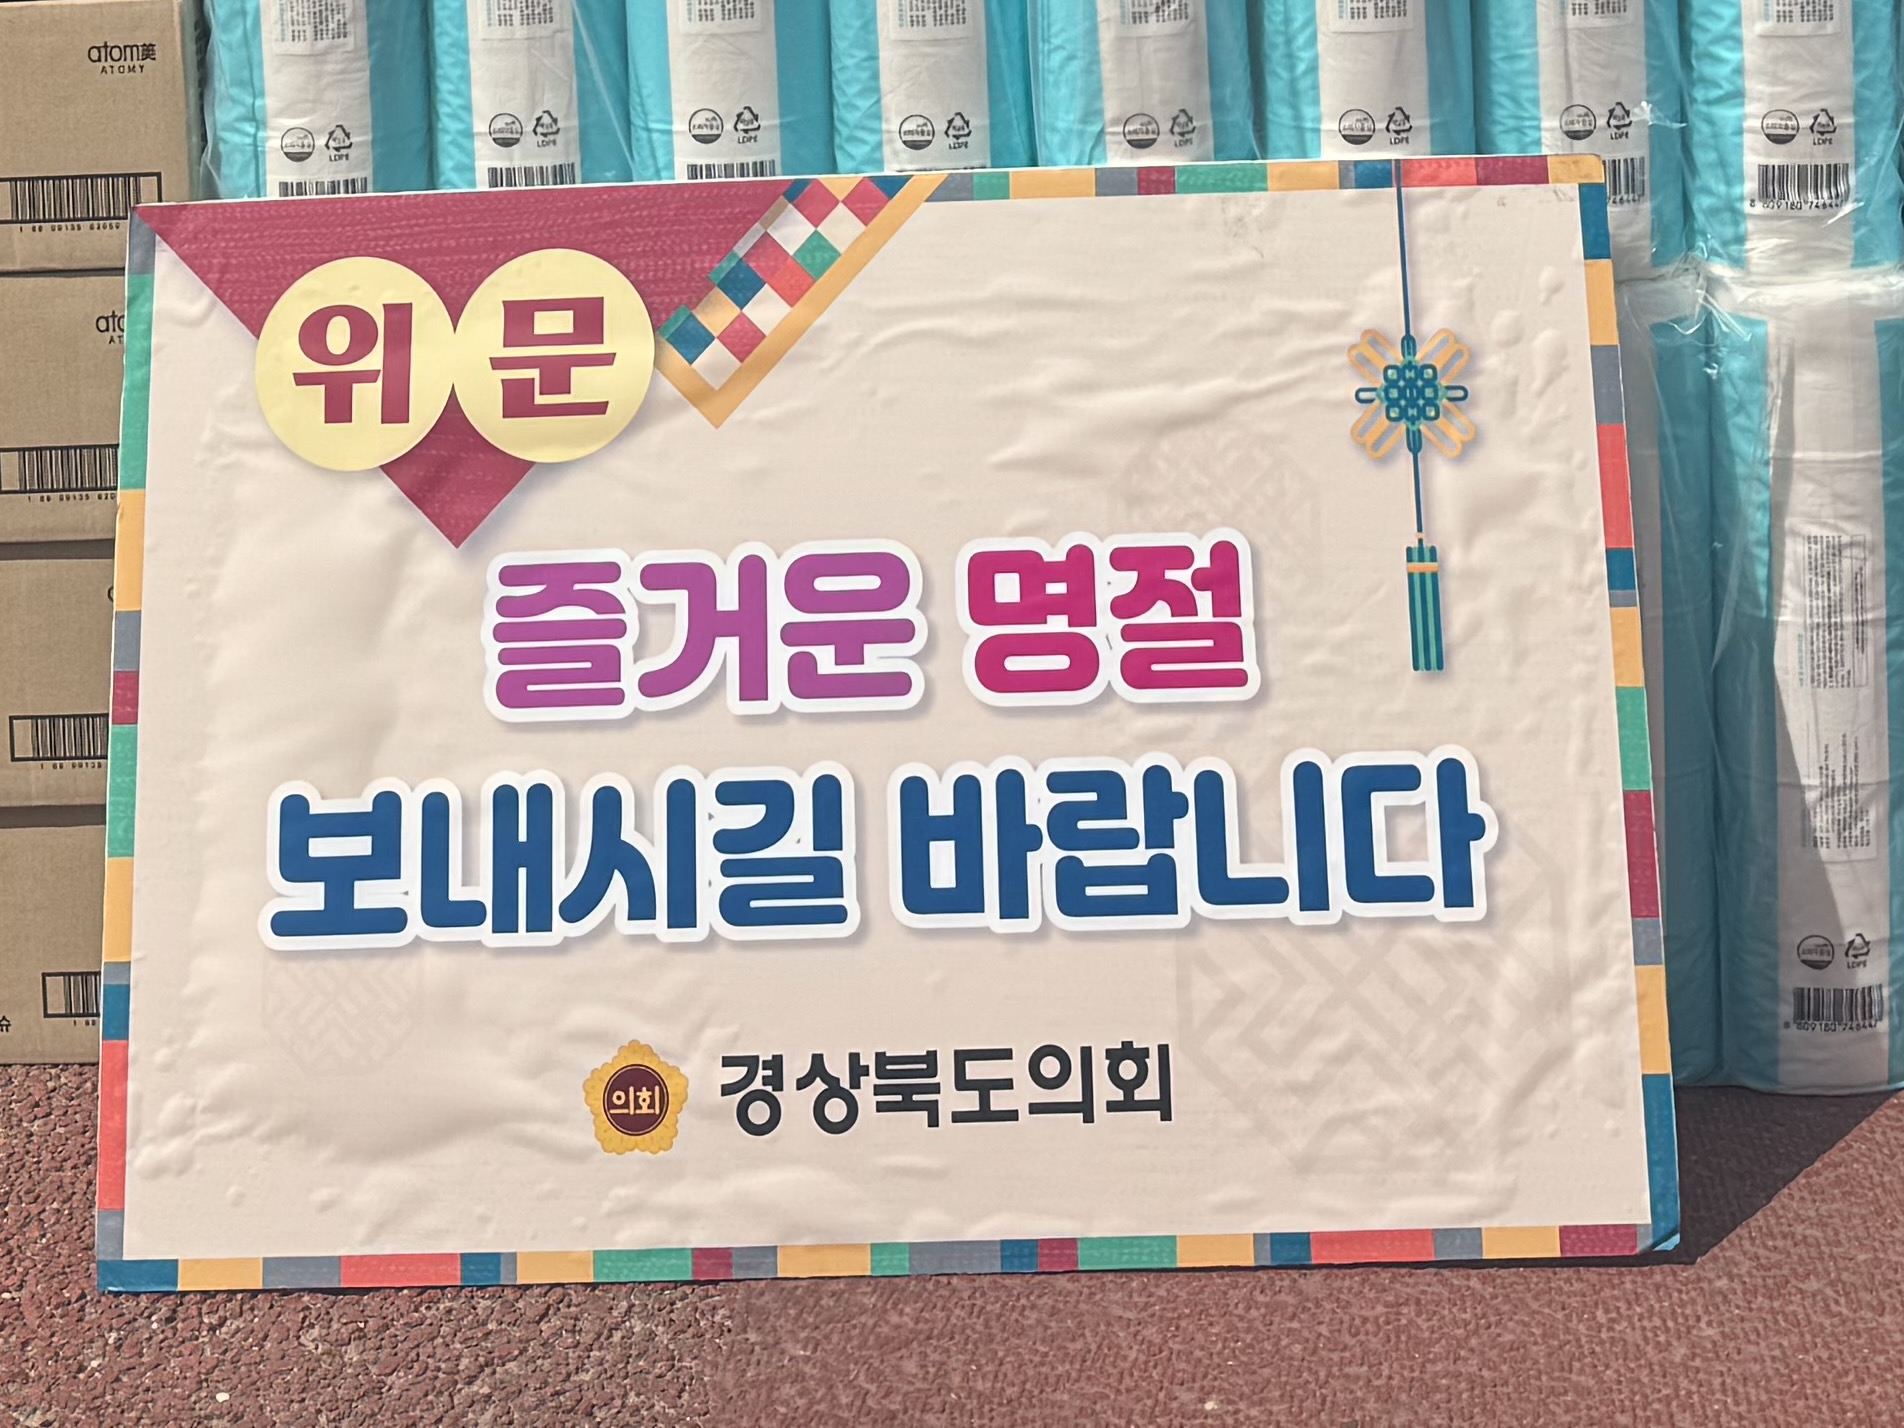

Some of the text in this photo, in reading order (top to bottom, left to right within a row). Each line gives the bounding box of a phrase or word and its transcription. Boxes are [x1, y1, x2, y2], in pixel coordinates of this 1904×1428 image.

[101, 65, 145, 74] ATOMY
[488, 537, 1254, 715] 즐거운 명절
[267, 752, 1491, 939] 보내시길 바랍니다
[609, 1085, 660, 1115] 의회
[720, 1040, 1174, 1137] 경상북도의회
